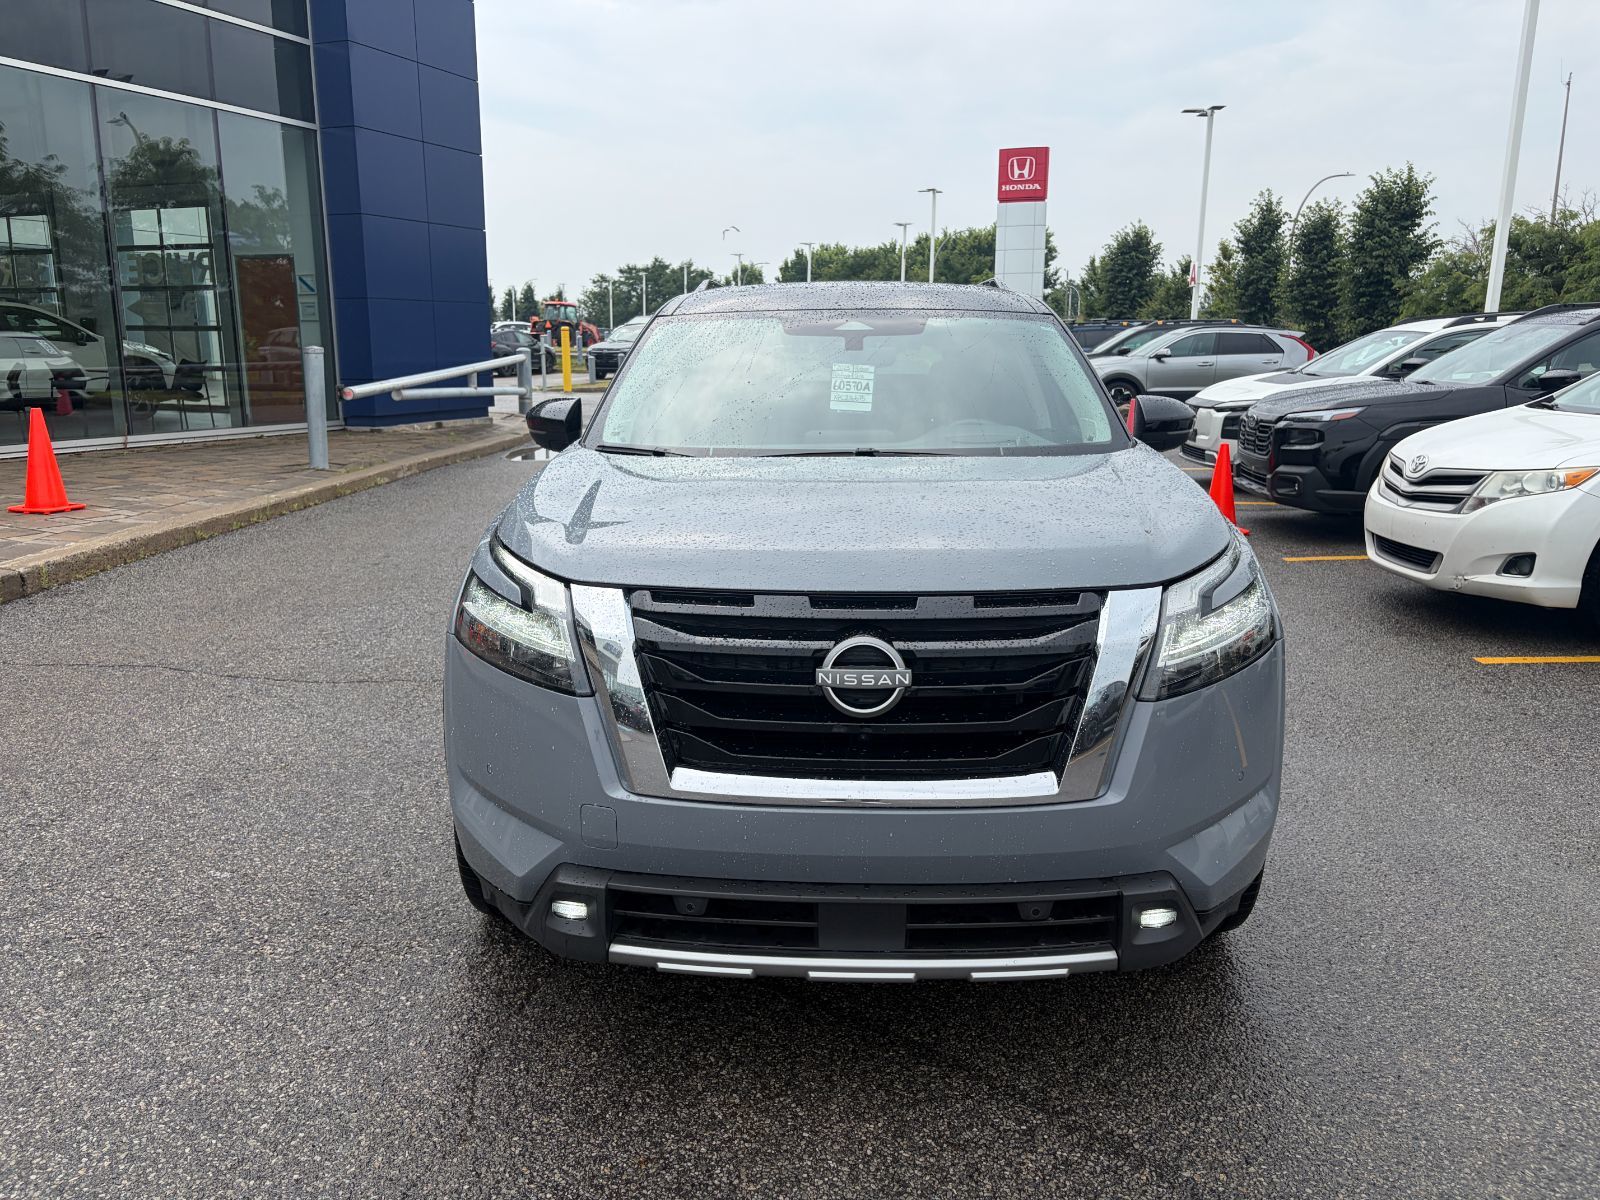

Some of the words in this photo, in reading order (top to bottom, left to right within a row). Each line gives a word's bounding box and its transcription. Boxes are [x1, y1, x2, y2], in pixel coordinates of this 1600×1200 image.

[1001, 183, 1042, 191] HONDA
[832, 379, 871, 392] 60570A
[818, 672, 909, 686] NISSAN
